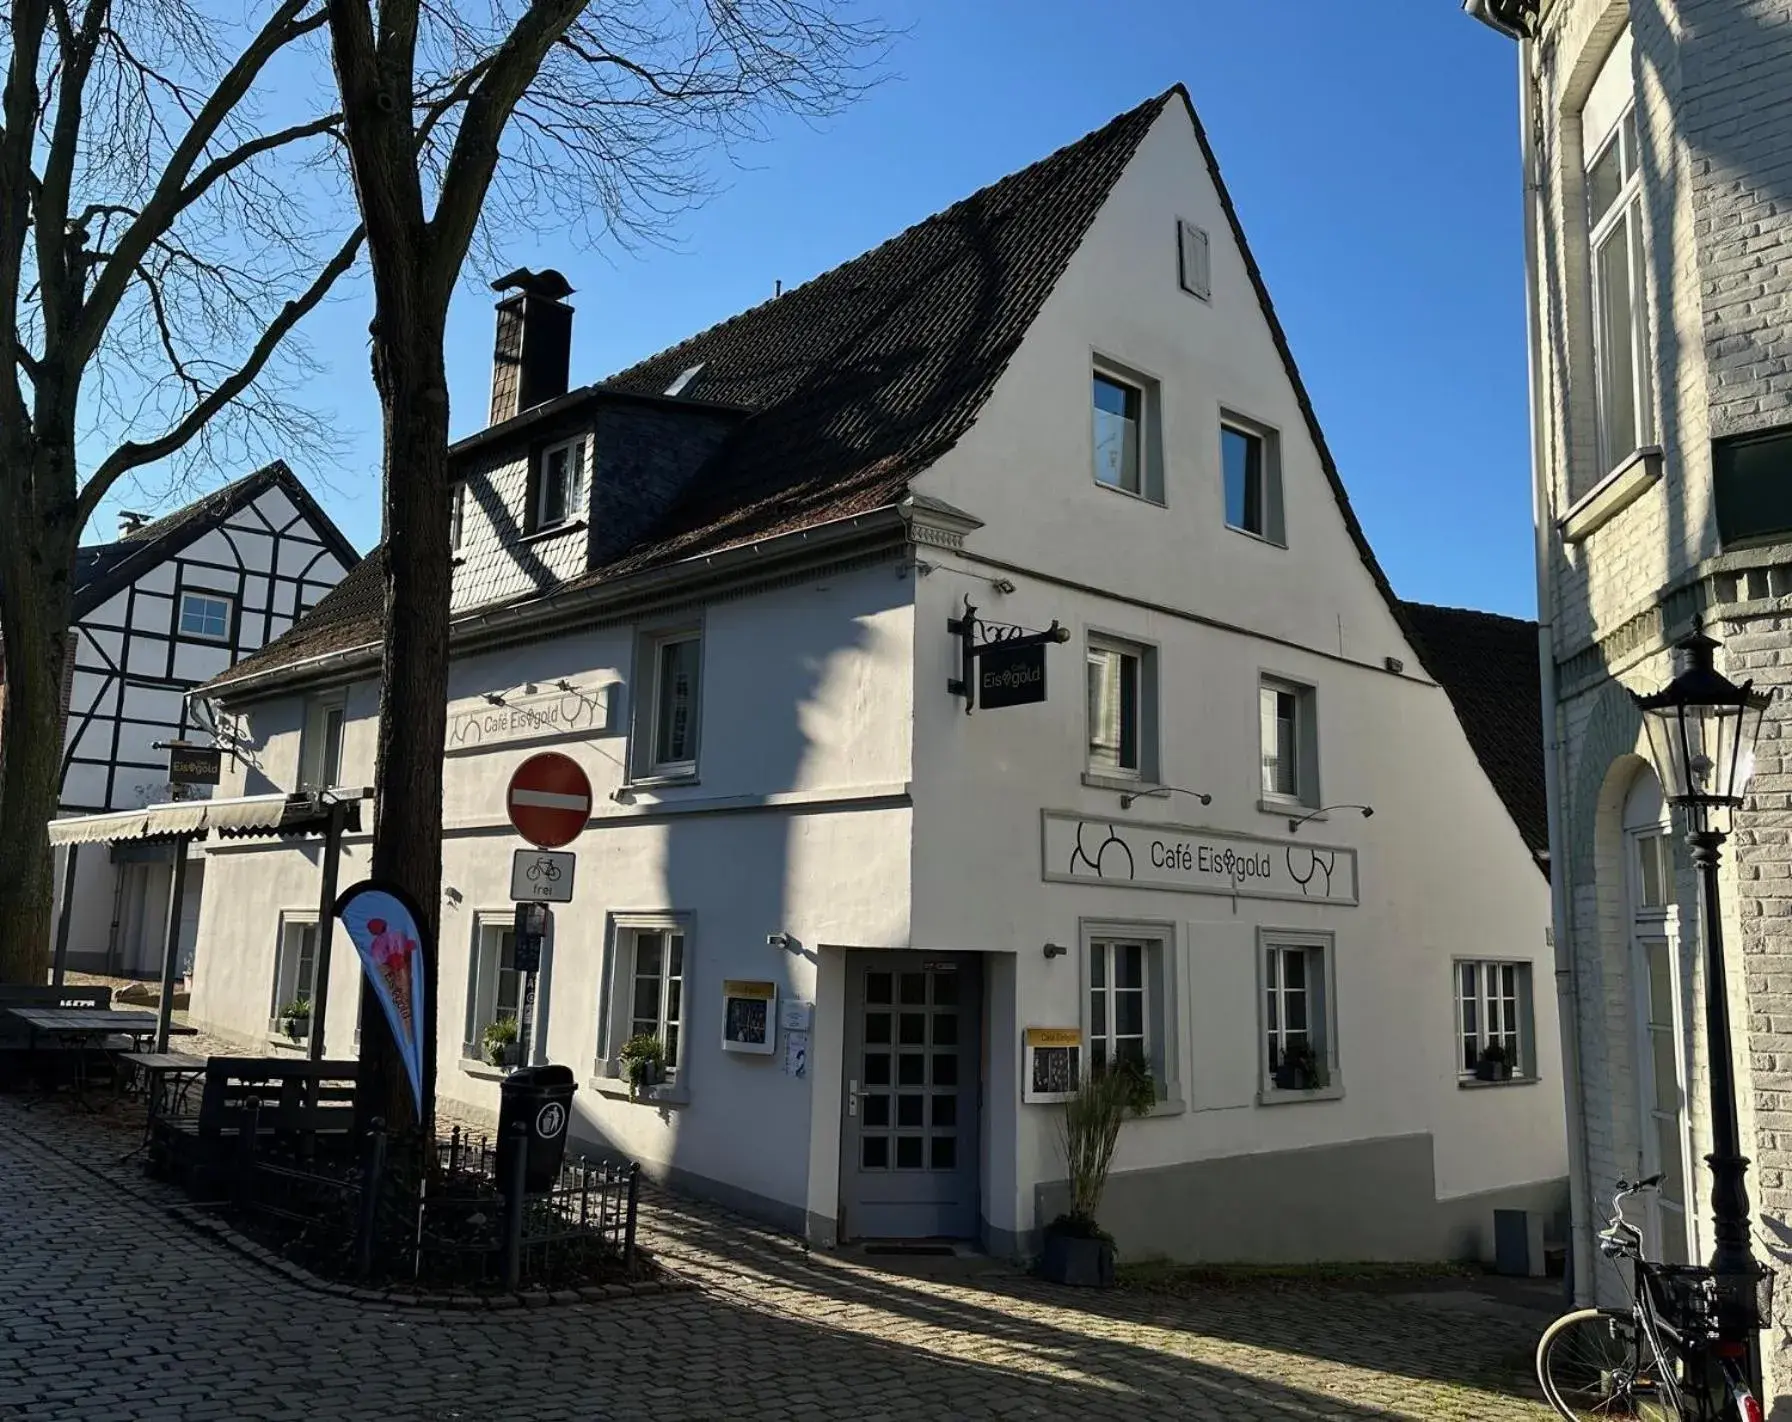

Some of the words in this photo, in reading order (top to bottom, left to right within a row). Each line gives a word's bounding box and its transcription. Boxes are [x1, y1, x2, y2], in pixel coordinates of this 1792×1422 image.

[484, 712, 507, 734] Café
[1150, 841, 1193, 871] Café
[533, 884, 553, 896] frei
